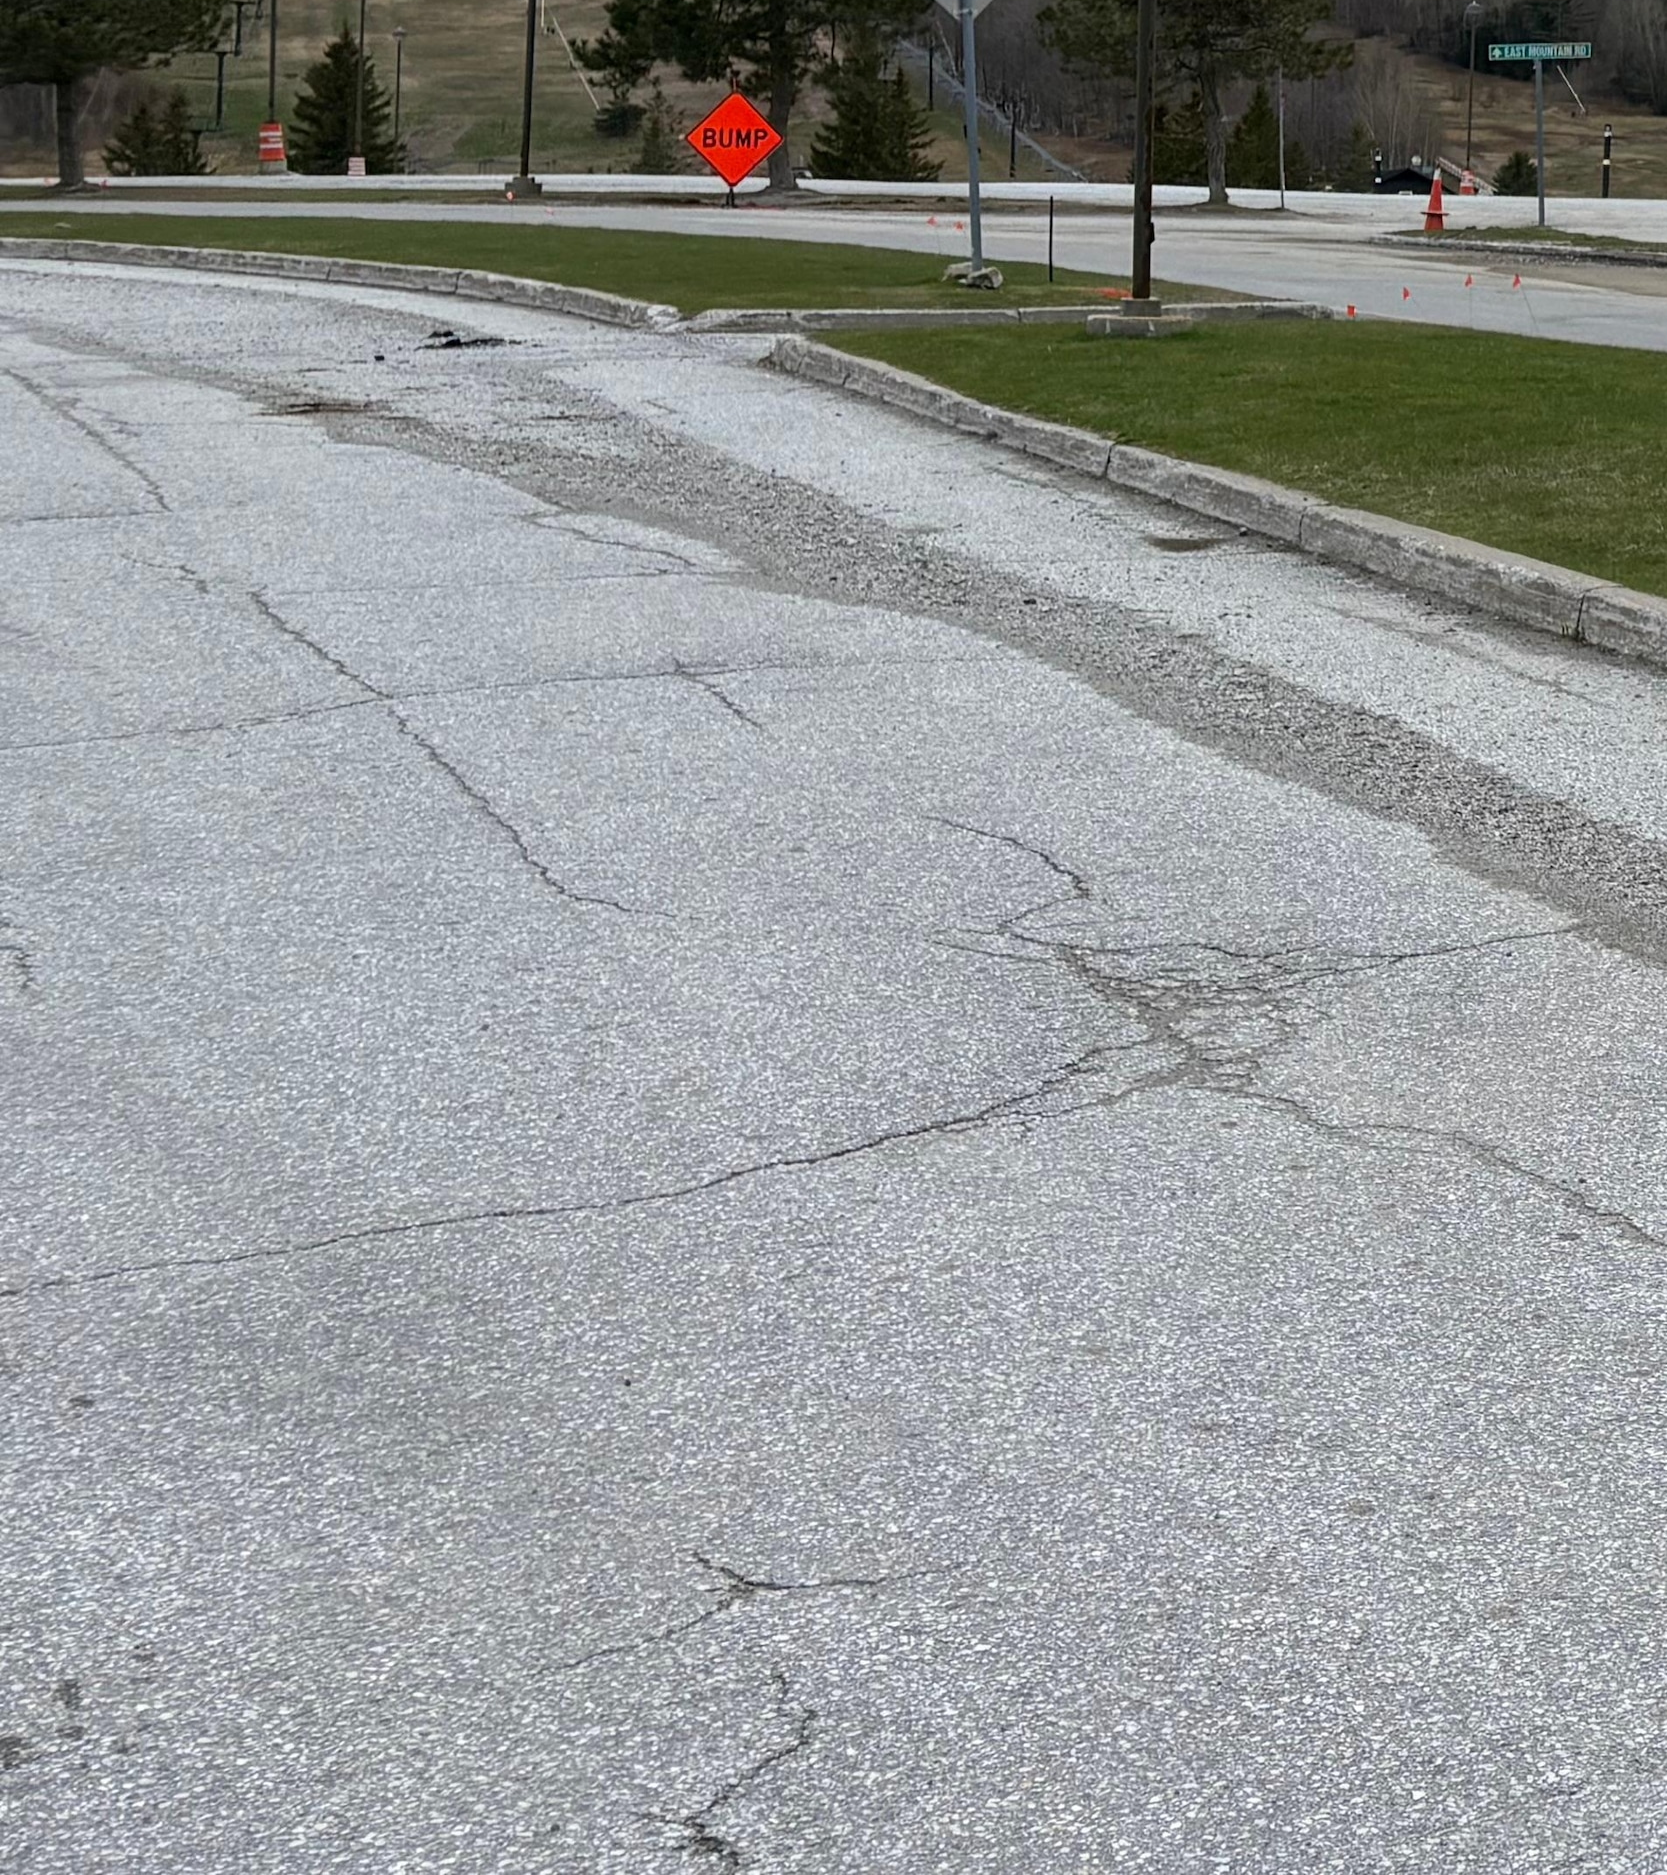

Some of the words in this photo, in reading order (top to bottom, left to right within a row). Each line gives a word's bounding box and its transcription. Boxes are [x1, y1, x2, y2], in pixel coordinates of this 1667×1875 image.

[1504, 46, 1526, 58] EAST
[1529, 45, 1573, 57] MOUNTAIN
[1575, 45, 1587, 56] RD
[702, 127, 769, 149] BUMP
